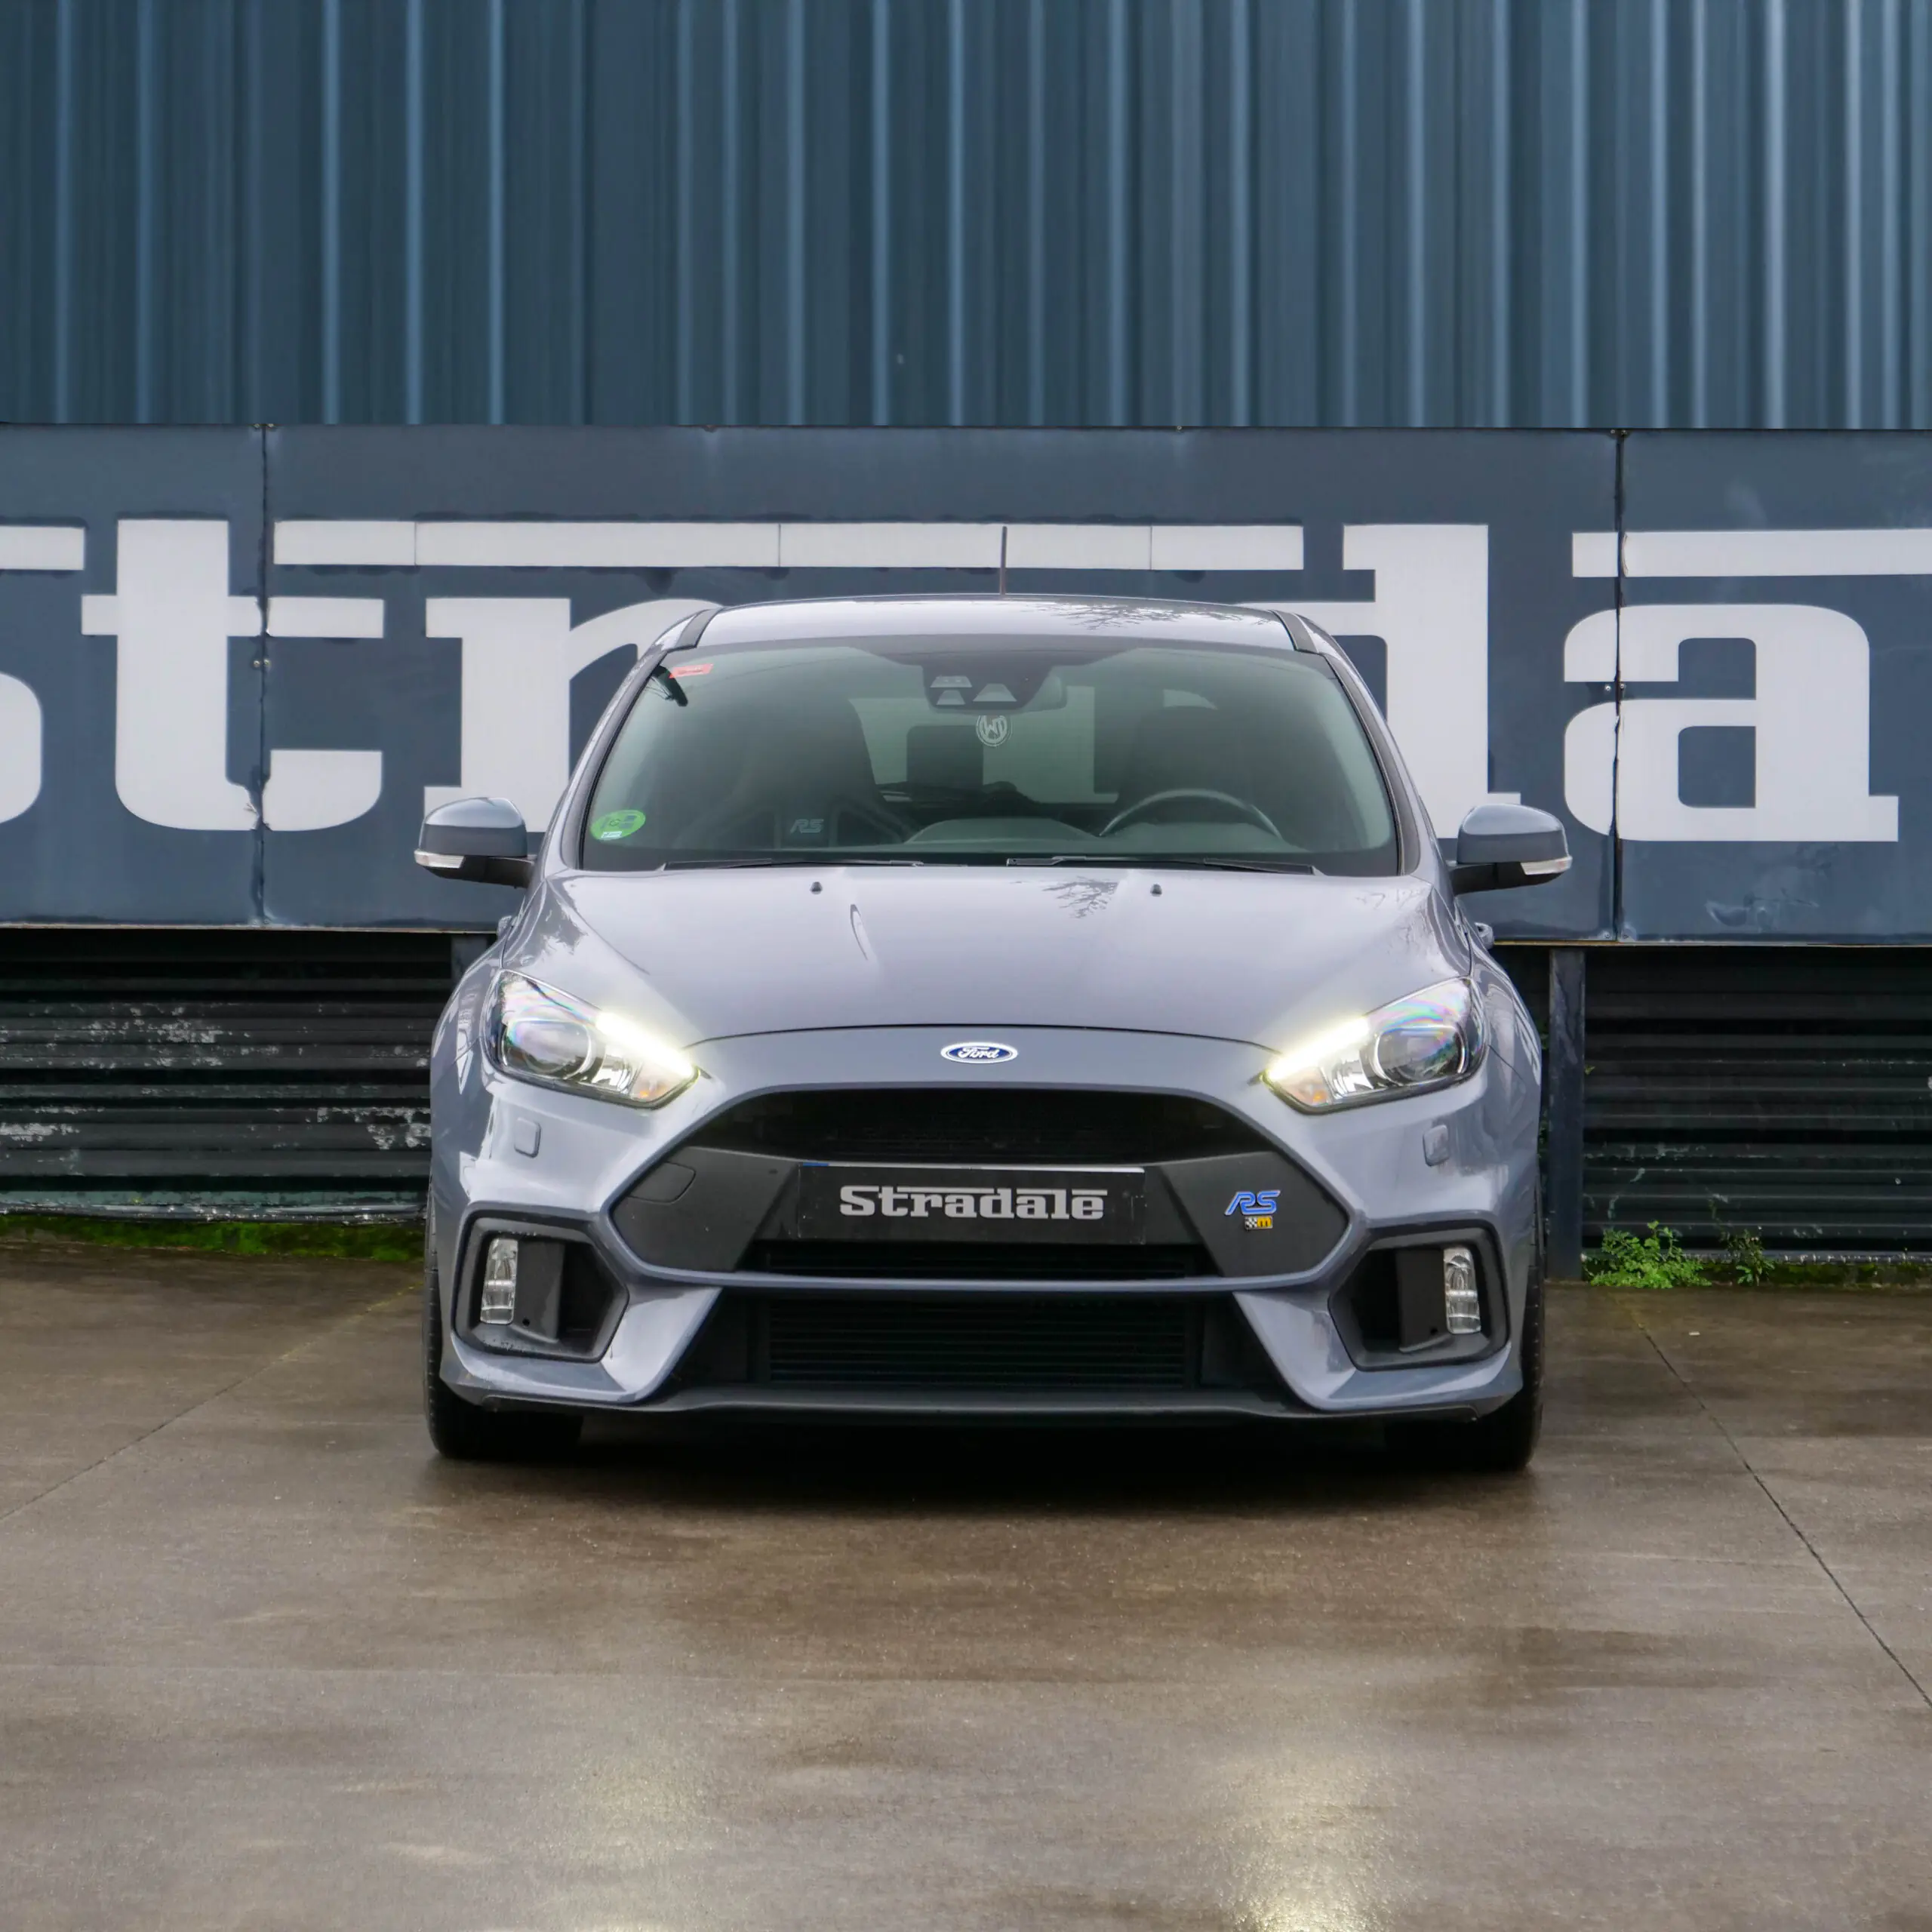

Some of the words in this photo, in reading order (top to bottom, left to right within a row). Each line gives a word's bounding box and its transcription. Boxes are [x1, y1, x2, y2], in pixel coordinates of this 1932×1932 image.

[790, 818, 825, 834] RS
[957, 1047, 1001, 1059] Ford
[839, 1185, 1108, 1220] Stradale
[1224, 1189, 1281, 1216] RS
